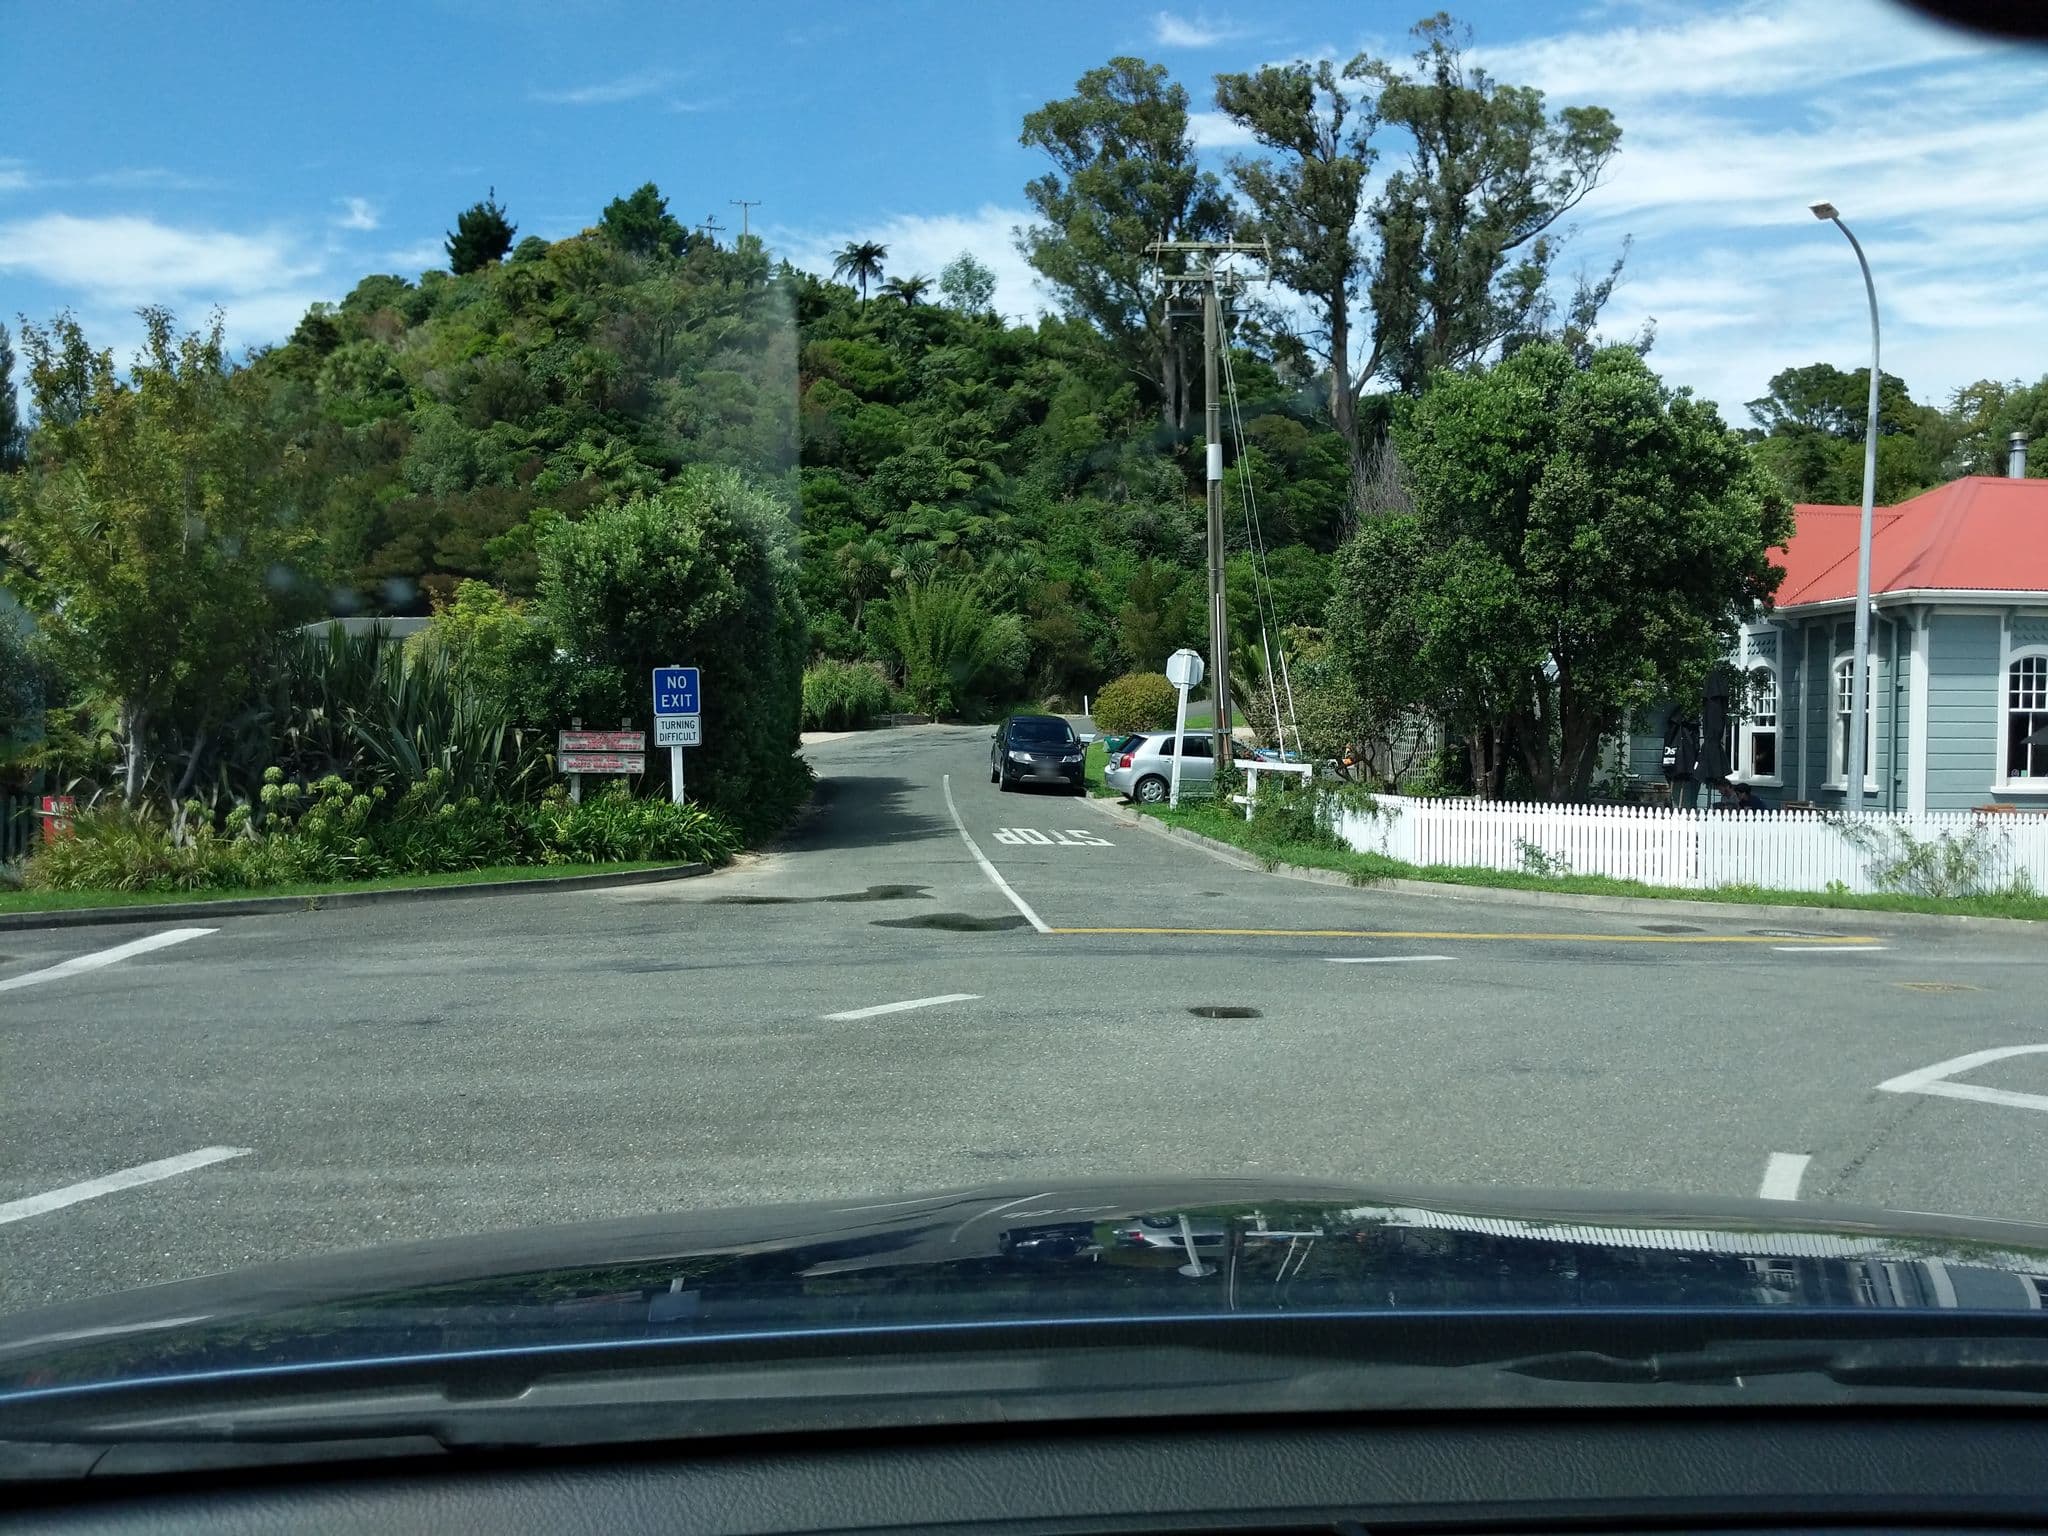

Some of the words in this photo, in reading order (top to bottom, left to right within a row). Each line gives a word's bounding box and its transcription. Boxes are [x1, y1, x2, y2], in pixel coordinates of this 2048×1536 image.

[667, 676, 687, 689] NO
[661, 694, 692, 707] EXIT
[661, 720, 695, 730] TURNING
[660, 732, 696, 742] DIFFICULT
[992, 828, 1116, 847] STOP
